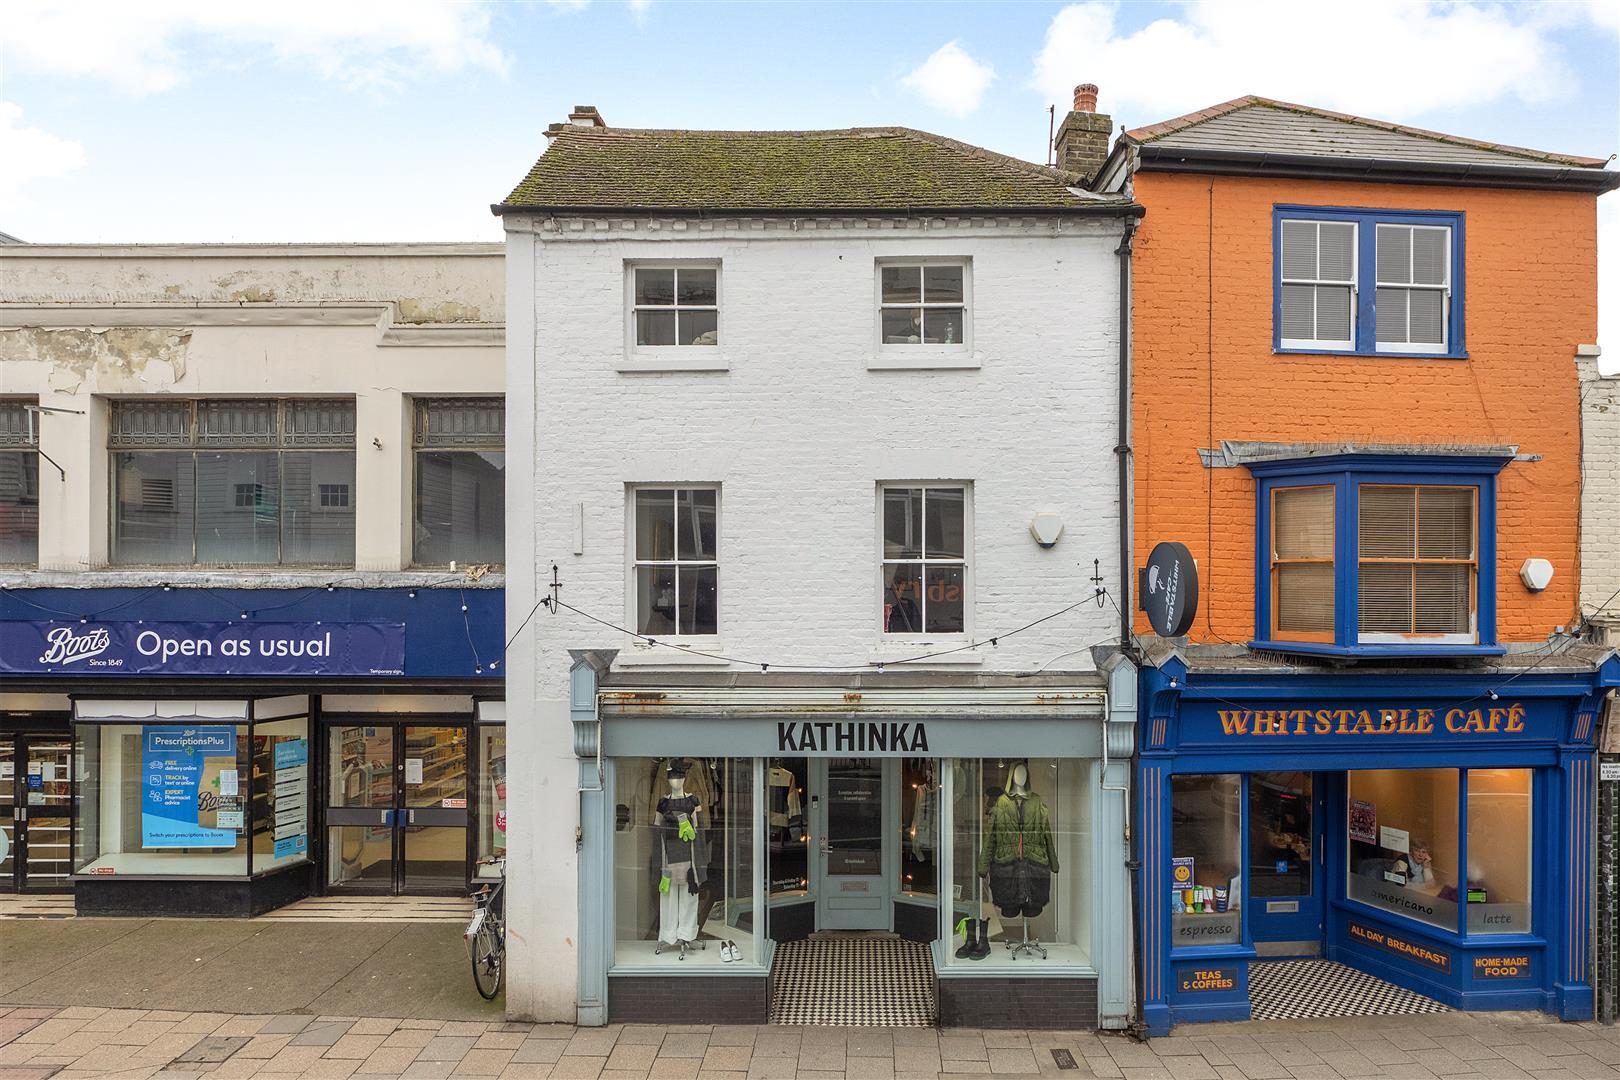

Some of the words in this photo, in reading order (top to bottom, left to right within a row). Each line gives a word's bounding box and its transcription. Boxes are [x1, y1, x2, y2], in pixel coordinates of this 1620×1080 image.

[1167, 560, 1180, 632] WHITSTABLE
[38, 627, 110, 665] Boots
[136, 630, 212, 664] Open
[220, 639, 251, 657] as
[260, 632, 331, 657] usual
[89, 659, 106, 667] Since
[107, 659, 123, 667] 1849
[1217, 708, 1435, 736] WHITSTABLE
[1444, 702, 1526, 734] CAFÉ
[155, 736, 225, 747] PrescriptionsPlus
[777, 722, 929, 752] KATHINKA
[1370, 889, 1434, 916] americano
[1483, 911, 1512, 925] latte
[1180, 925, 1233, 940] espresso
[1351, 925, 1366, 938] ALL
[1366, 930, 1385, 944] DAY
[1386, 937, 1449, 966] BREAKFAST
[1475, 957, 1529, 967] HOME-MADE
[1194, 970, 1222, 980] TEAS
[1484, 967, 1519, 977] FOOD
[1183, 981, 1191, 990] &
[1192, 979, 1233, 989] COFFEES
